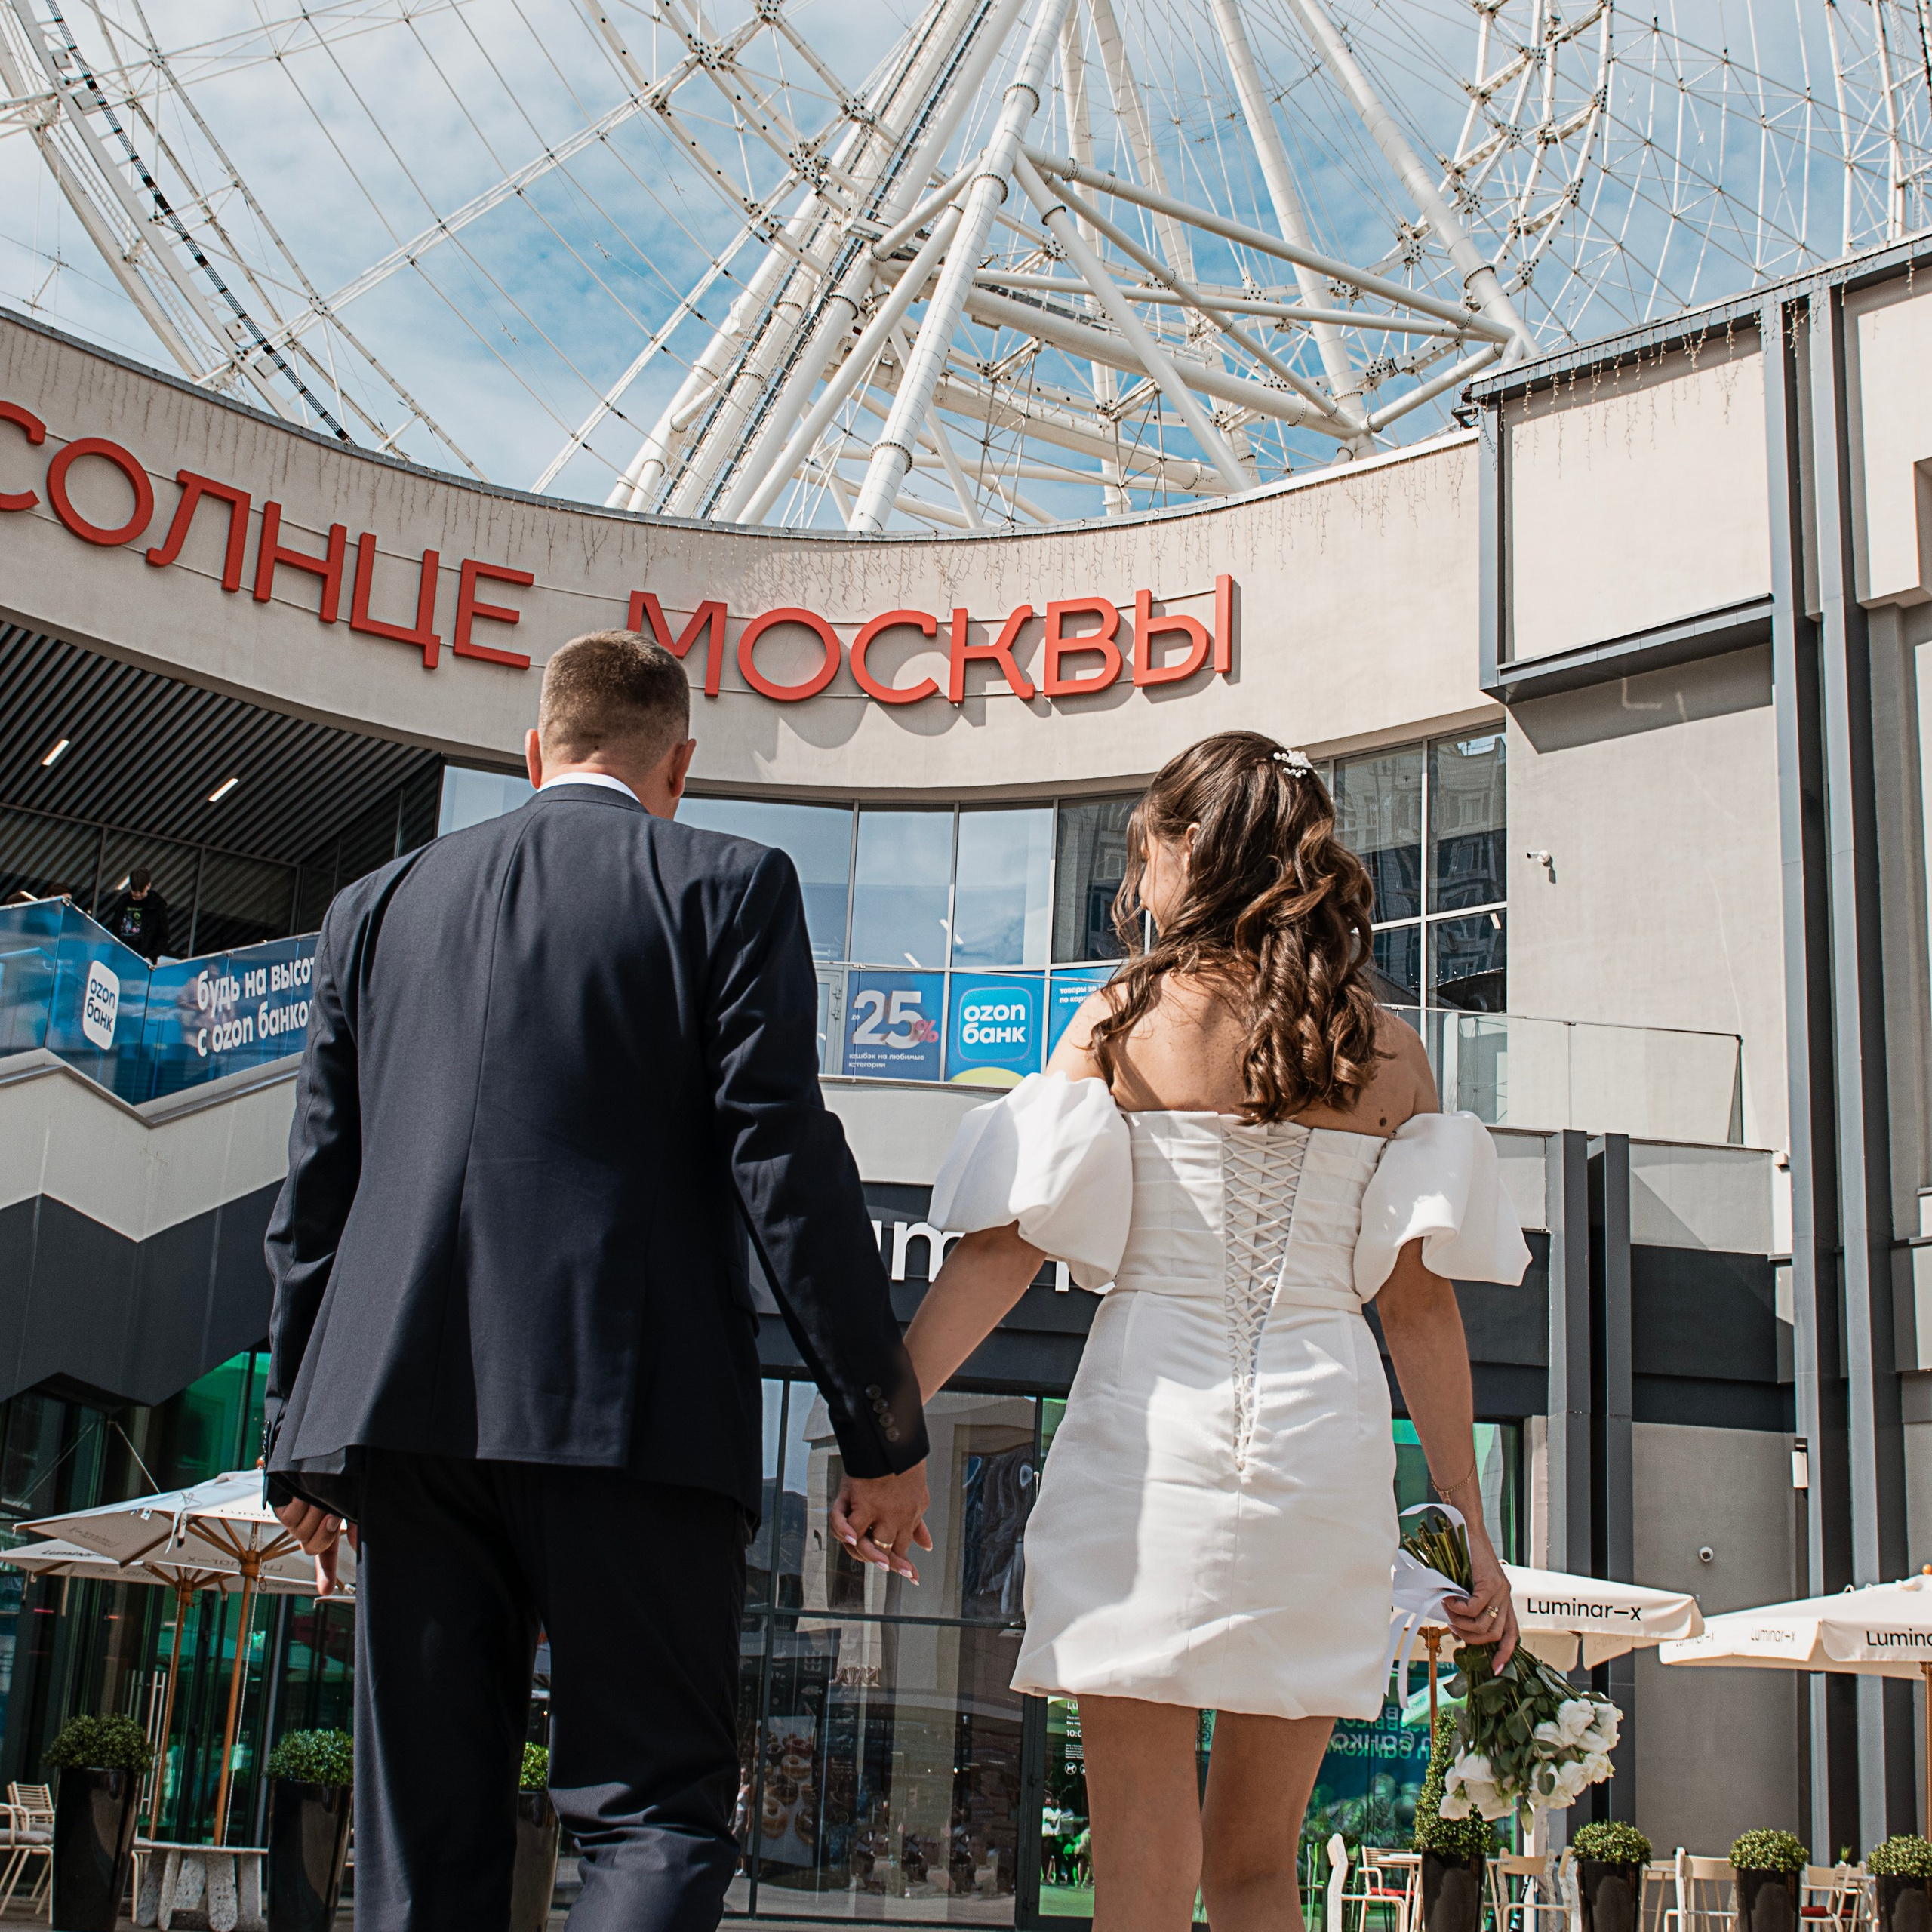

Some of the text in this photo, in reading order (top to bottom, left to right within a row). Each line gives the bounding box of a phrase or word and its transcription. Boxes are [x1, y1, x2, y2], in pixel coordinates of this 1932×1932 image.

[626, 574, 1233, 704] МОСКВЫ
[90, 978, 115, 1009] ozon
[197, 970, 240, 1018] будь
[245, 968, 266, 998] на
[87, 996, 113, 1032] банк
[198, 1000, 312, 1057] с ozon банко
[963, 1003, 1026, 1021] ozon
[962, 1022, 1026, 1044] банк
[889, 1053, 924, 1061] любимые
